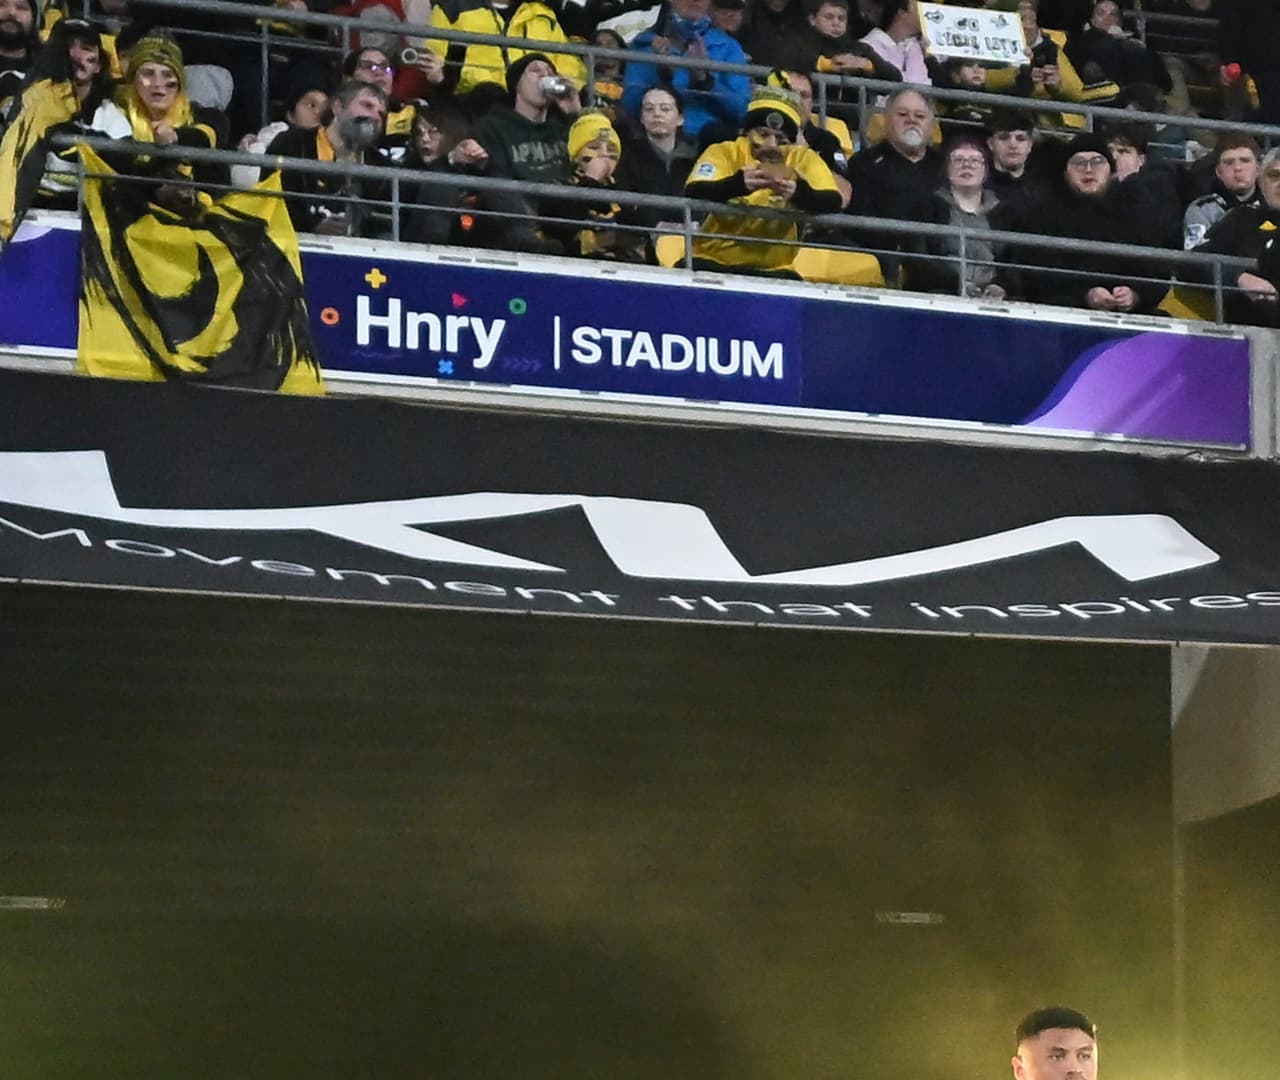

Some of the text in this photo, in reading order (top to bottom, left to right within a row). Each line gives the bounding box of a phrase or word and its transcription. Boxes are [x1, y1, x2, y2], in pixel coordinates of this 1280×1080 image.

[356, 295, 784, 379] Hnry STADIUM
[658, 594, 872, 618] that
